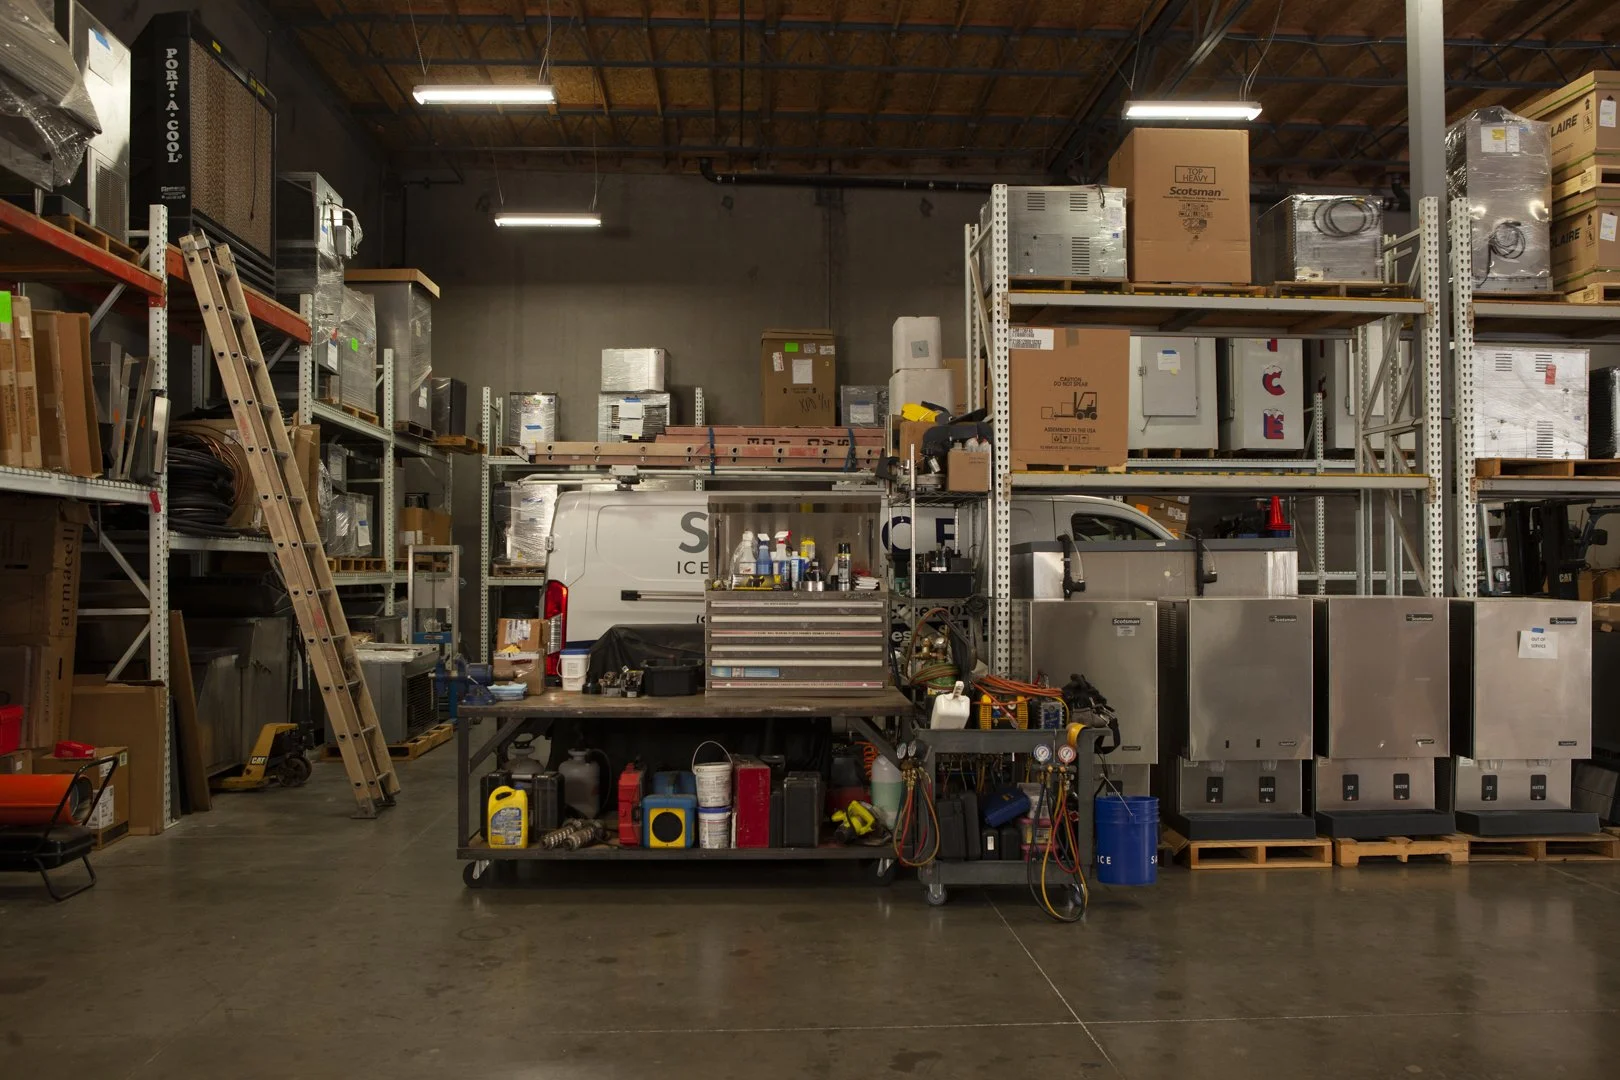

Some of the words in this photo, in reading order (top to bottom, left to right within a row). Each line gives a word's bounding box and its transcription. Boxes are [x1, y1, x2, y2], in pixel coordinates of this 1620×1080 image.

[1188, 168, 1203, 176] TOP
[1169, 186, 1222, 197] Scotsman
[60, 527, 76, 627] armacell
[1559, 573, 1572, 583] CAT
[251, 757, 267, 765] CAT
[1097, 855, 1112, 865] ICE
